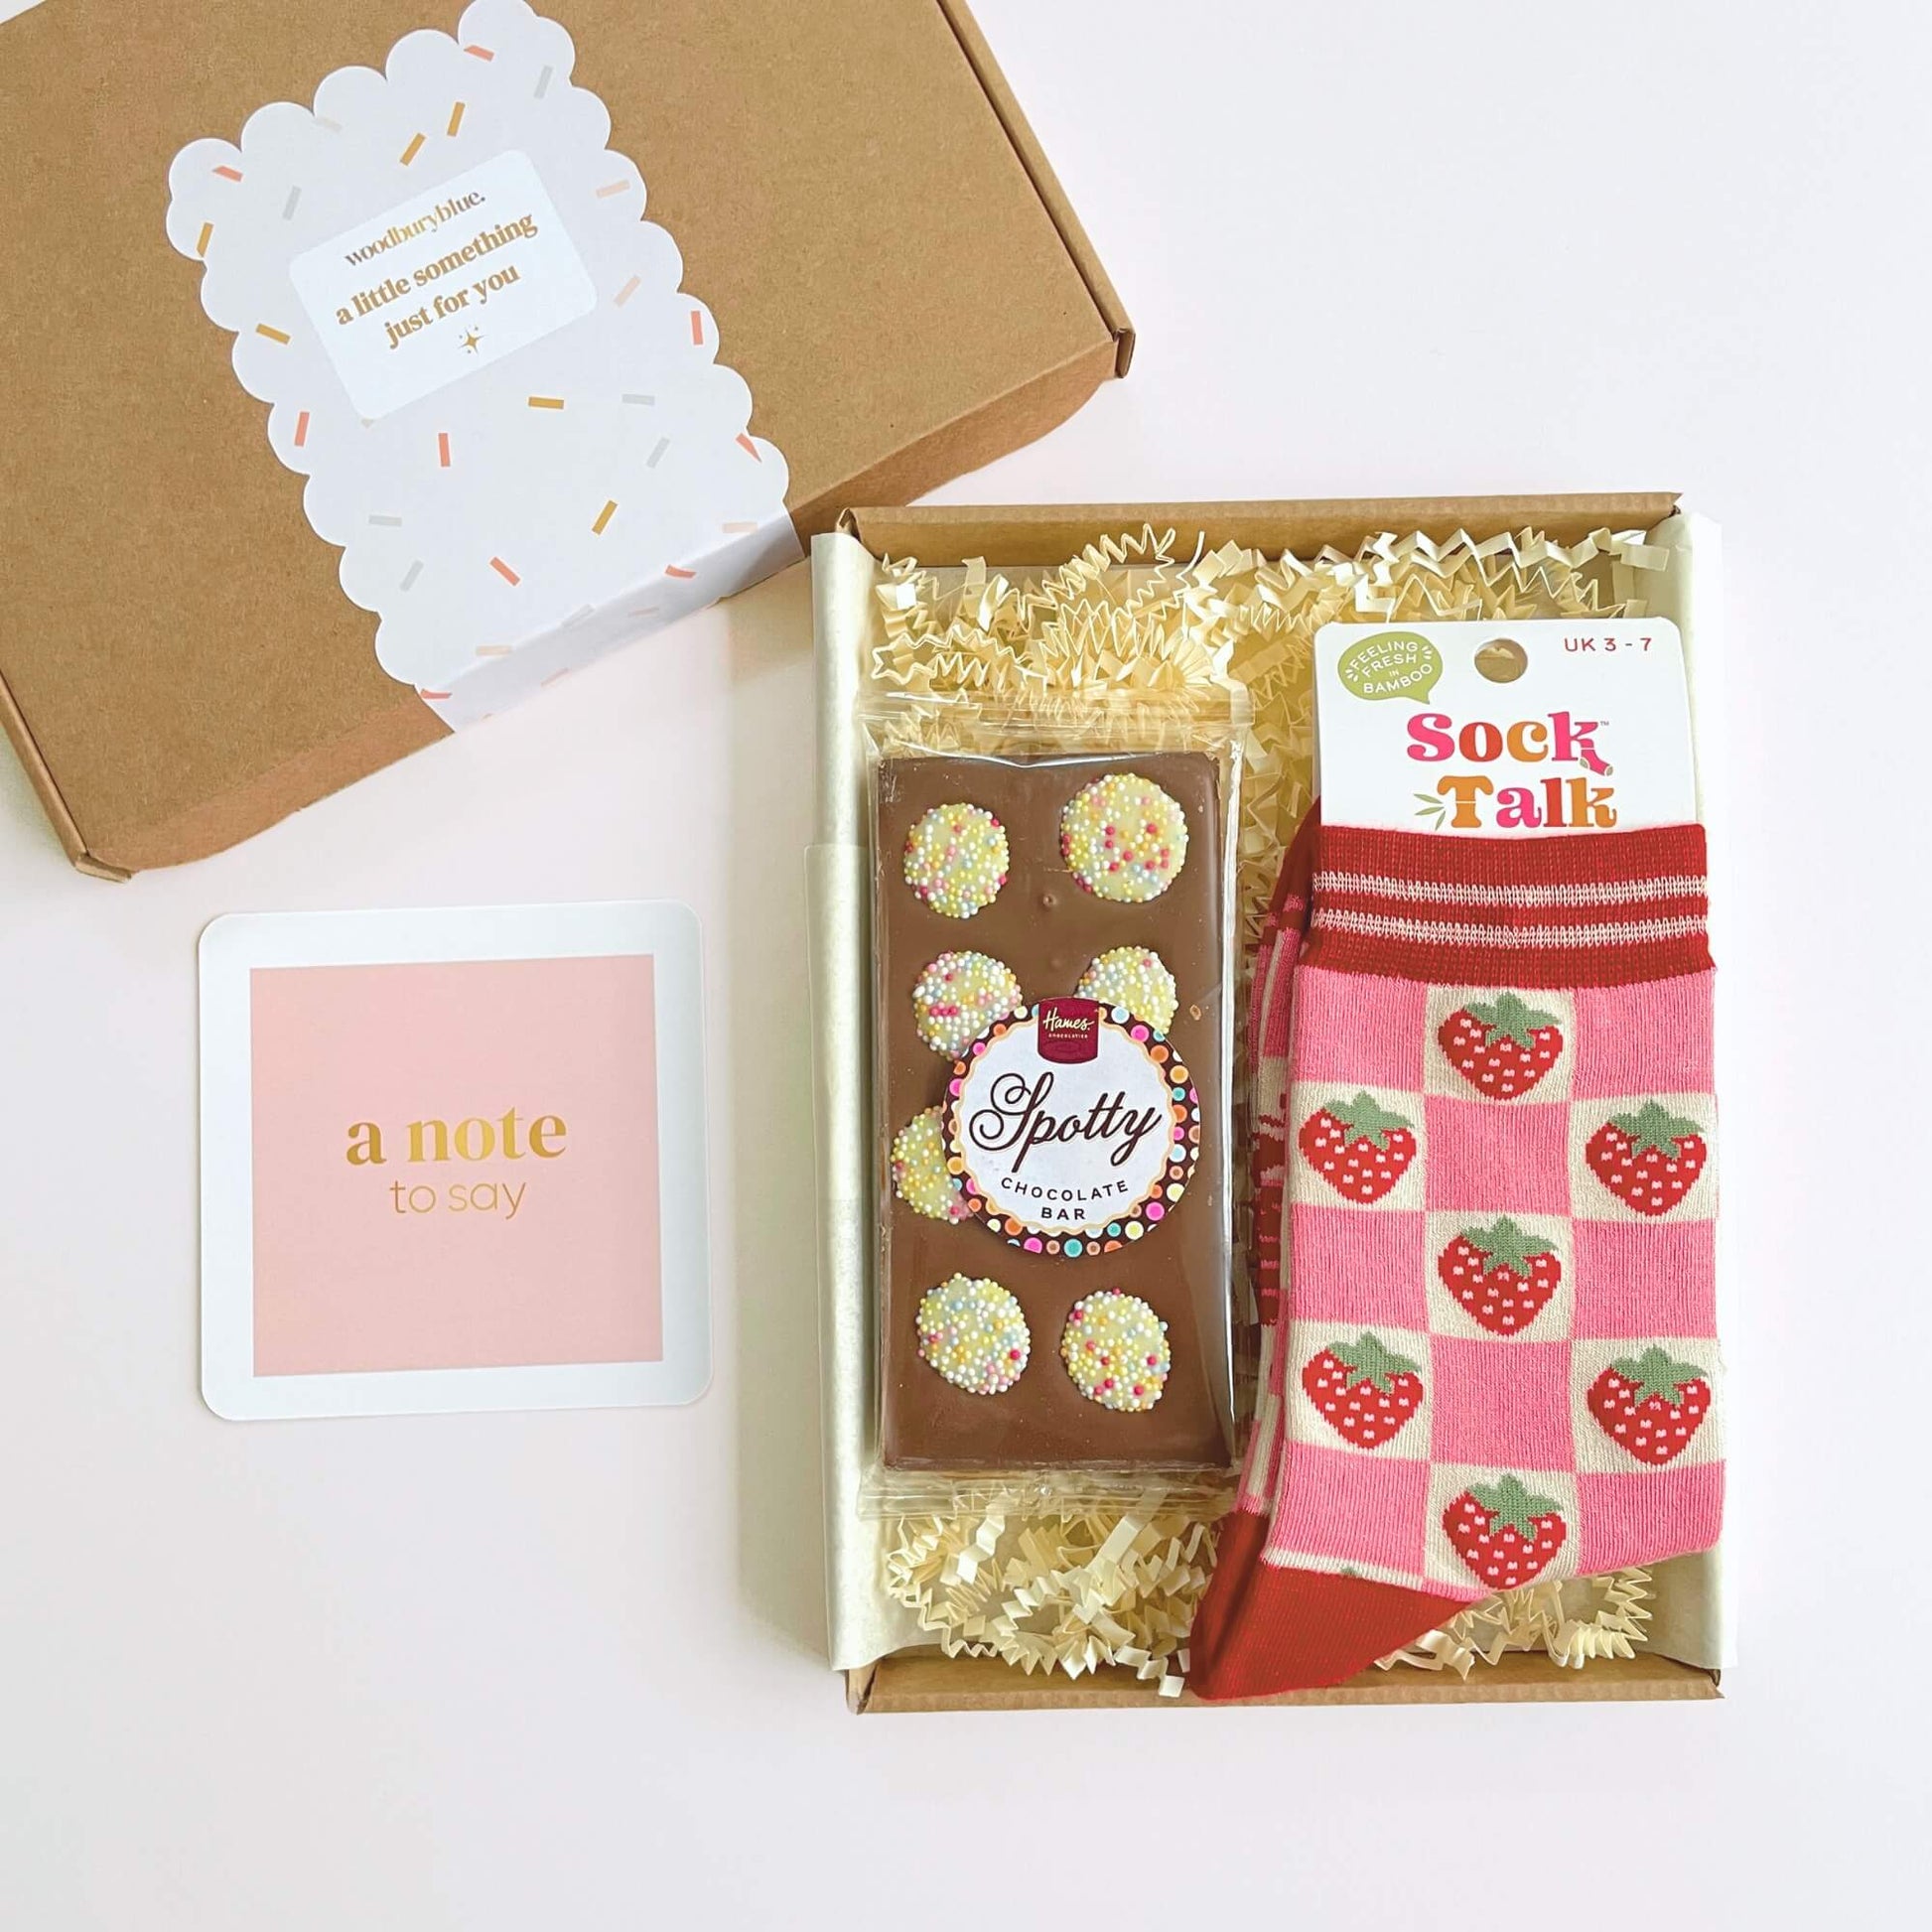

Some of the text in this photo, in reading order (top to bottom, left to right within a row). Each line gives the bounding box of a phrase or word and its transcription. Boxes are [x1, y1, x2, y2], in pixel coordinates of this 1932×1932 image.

[344, 191, 486, 266] woodburyblue.
[336, 213, 538, 326] a little something
[384, 265, 521, 349] just for you
[1349, 640, 1419, 671] FEELING
[1361, 653, 1417, 678] FRESH
[1564, 637, 1596, 652] UK
[1604, 637, 1617, 652] 3
[1639, 636, 1653, 651] 7
[1363, 663, 1433, 694] BAMBOO
[1406, 711, 1613, 775] Sock
[1437, 774, 1618, 829] Talk
[346, 1106, 567, 1166] a note
[969, 1071, 1163, 1173] Spotty
[389, 1180, 527, 1220] to say
[1001, 1177, 1129, 1201] CHOCOLATE
[1040, 1207, 1086, 1221] BAR
